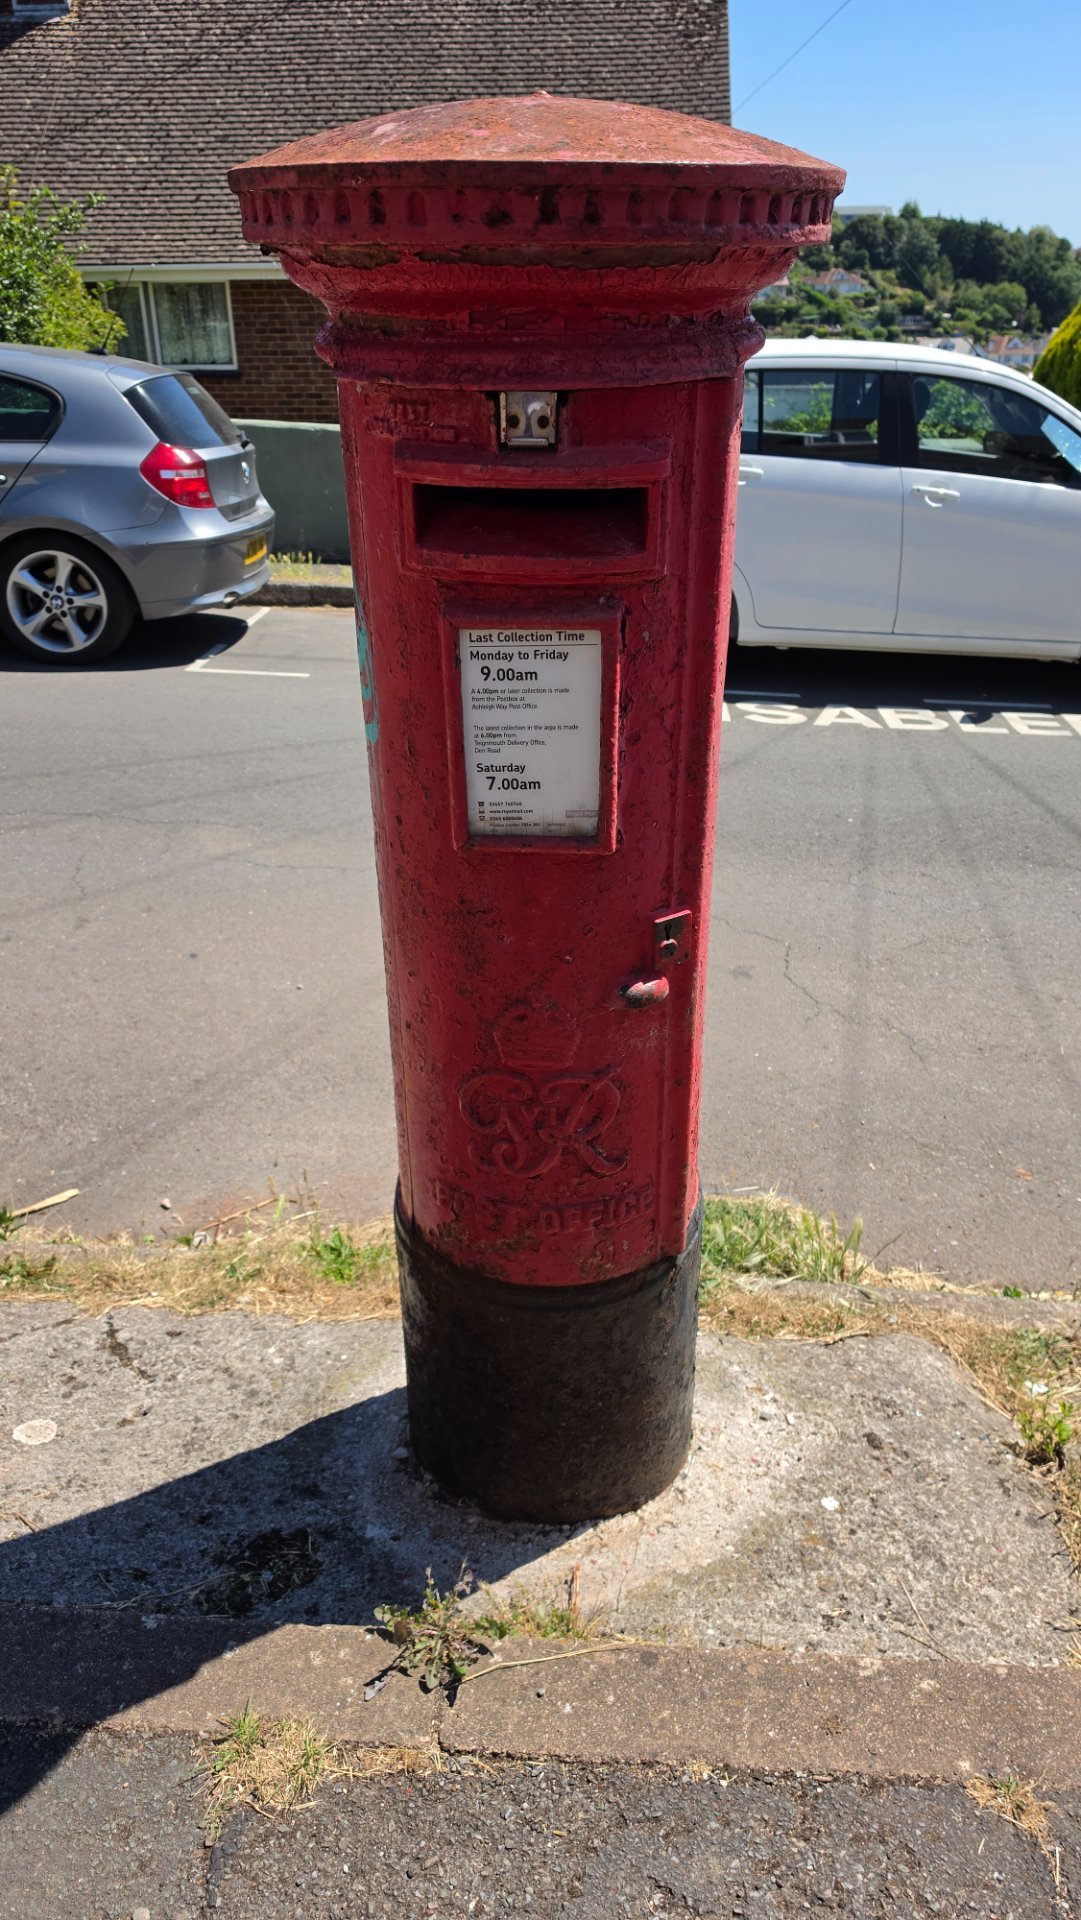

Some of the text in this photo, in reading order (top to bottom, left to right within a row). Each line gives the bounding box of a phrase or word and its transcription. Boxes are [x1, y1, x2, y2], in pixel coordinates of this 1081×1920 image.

[469, 632, 585, 642] Last Collection Time
[470, 650, 568, 662] Monday to Friday
[481, 666, 538, 681] 9.00am
[722, 700, 1081, 737] ISABLE
[477, 763, 525, 774] Saturday
[486, 777, 541, 790] 7.00am
[538, 1185, 656, 1234] OFFICE
